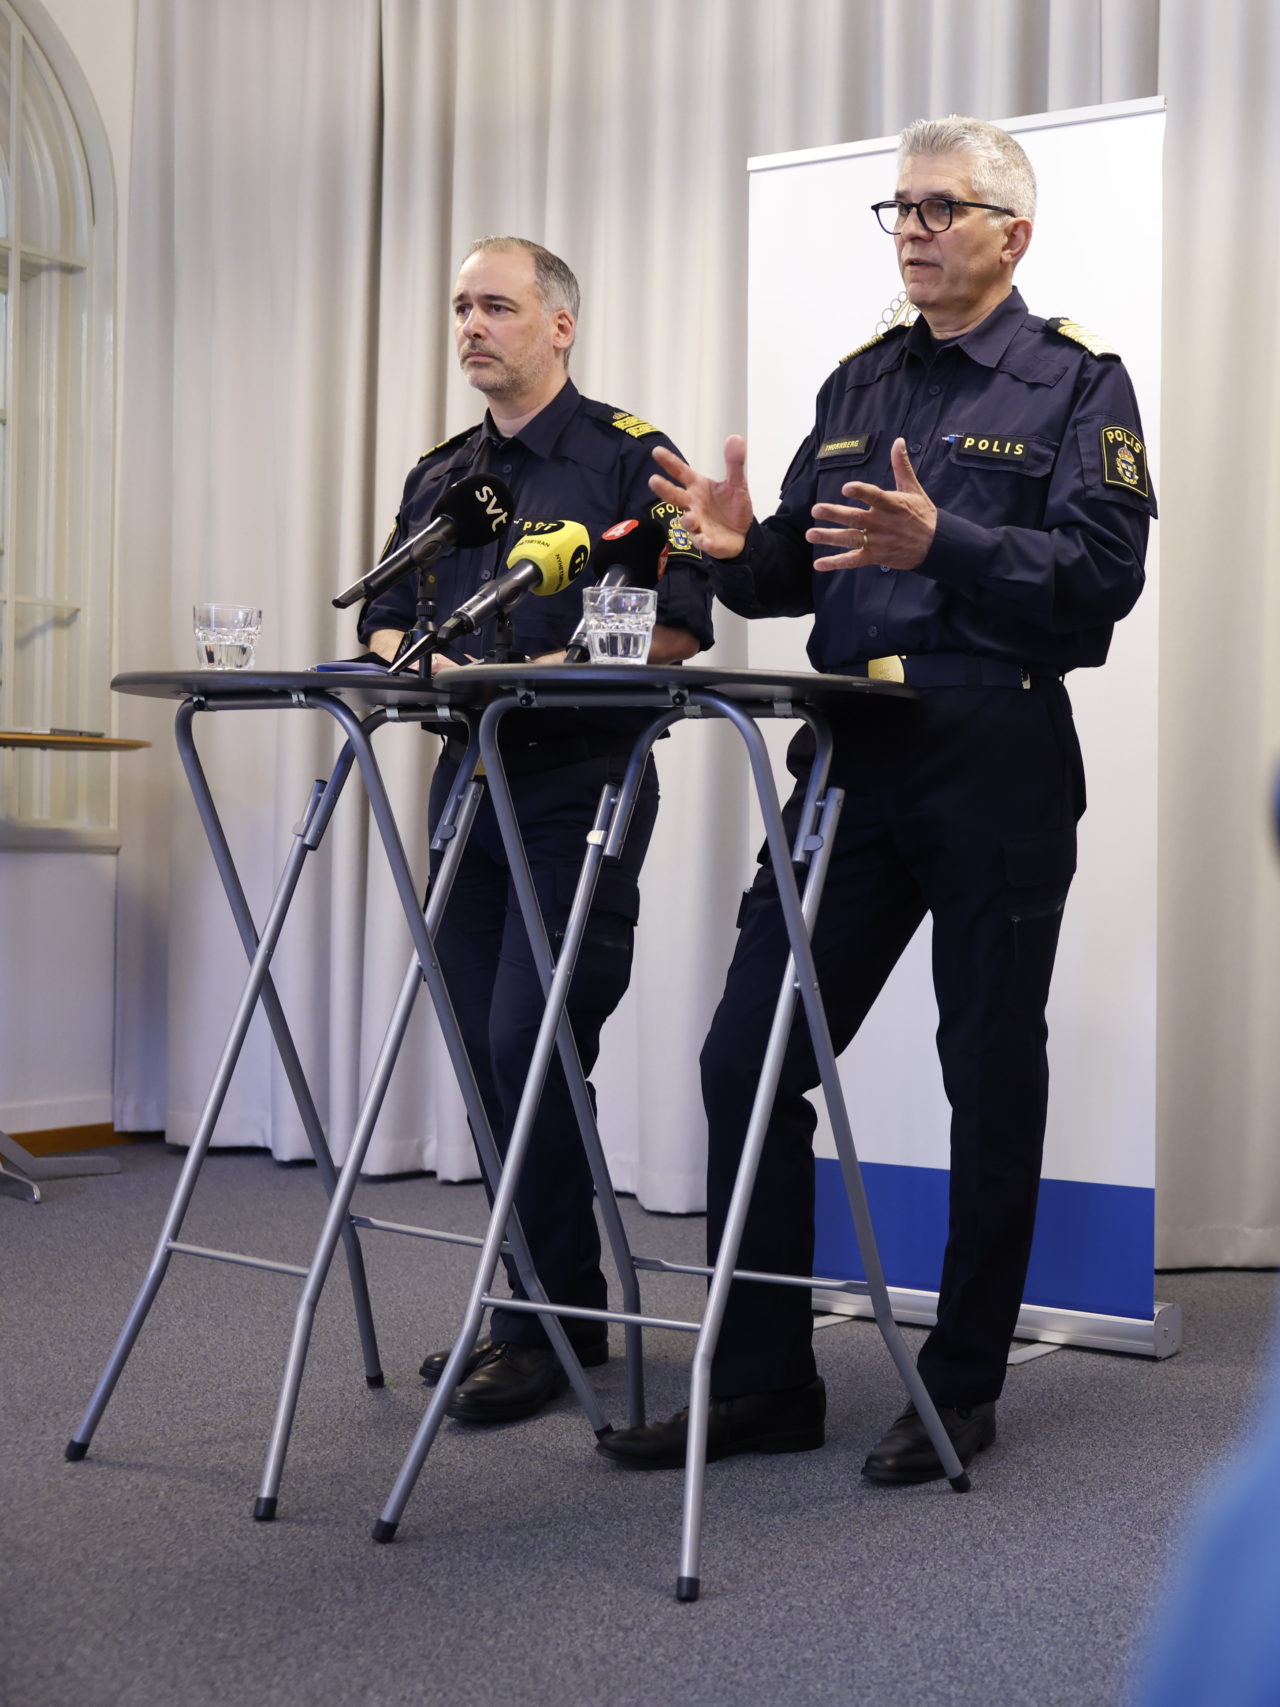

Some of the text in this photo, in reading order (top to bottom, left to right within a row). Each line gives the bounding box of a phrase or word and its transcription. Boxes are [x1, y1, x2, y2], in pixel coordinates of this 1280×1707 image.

[963, 437, 1025, 455] POLIS
[1106, 429, 1143, 454] POLIS
[655, 503, 687, 518] POL
